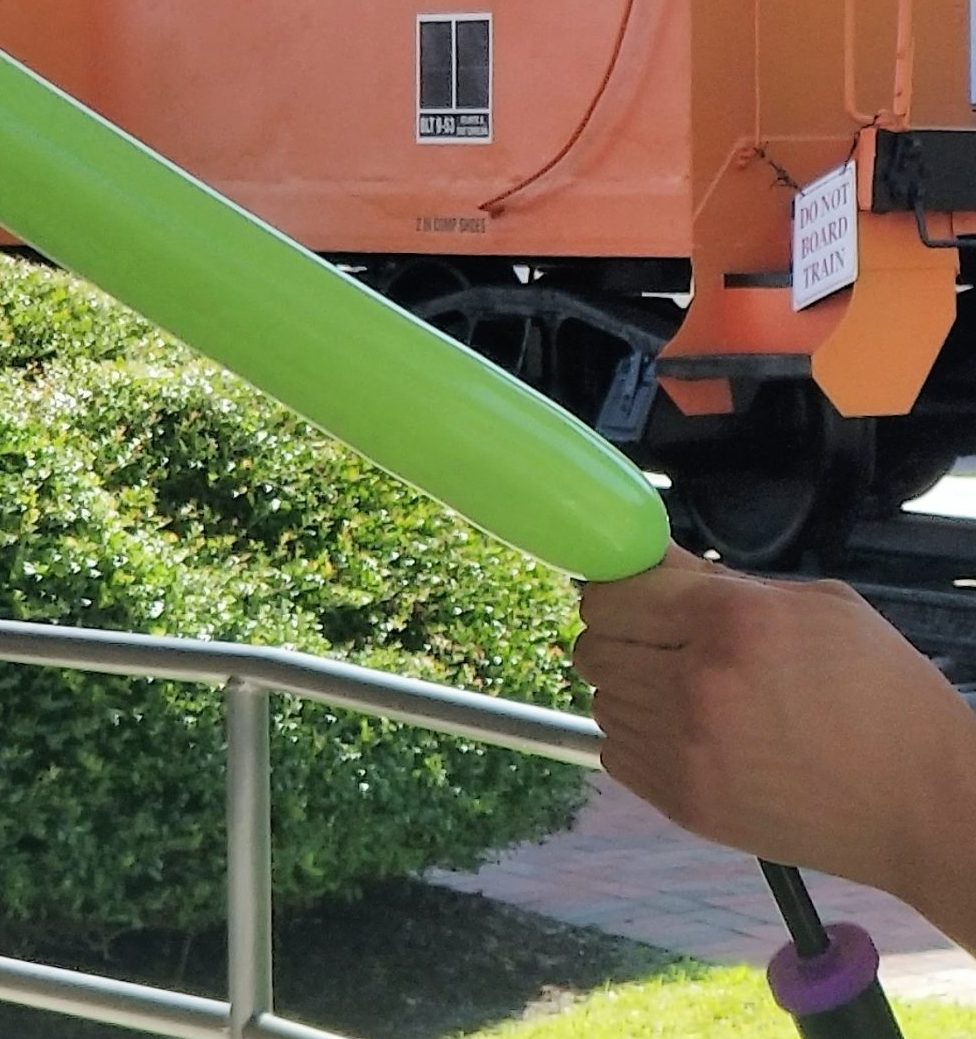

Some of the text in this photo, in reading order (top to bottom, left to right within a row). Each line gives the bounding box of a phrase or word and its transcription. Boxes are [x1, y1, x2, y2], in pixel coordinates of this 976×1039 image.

[800, 183, 849, 230] DO NOT
[801, 216, 848, 259] BOARD
[802, 248, 846, 289] TRAIN
